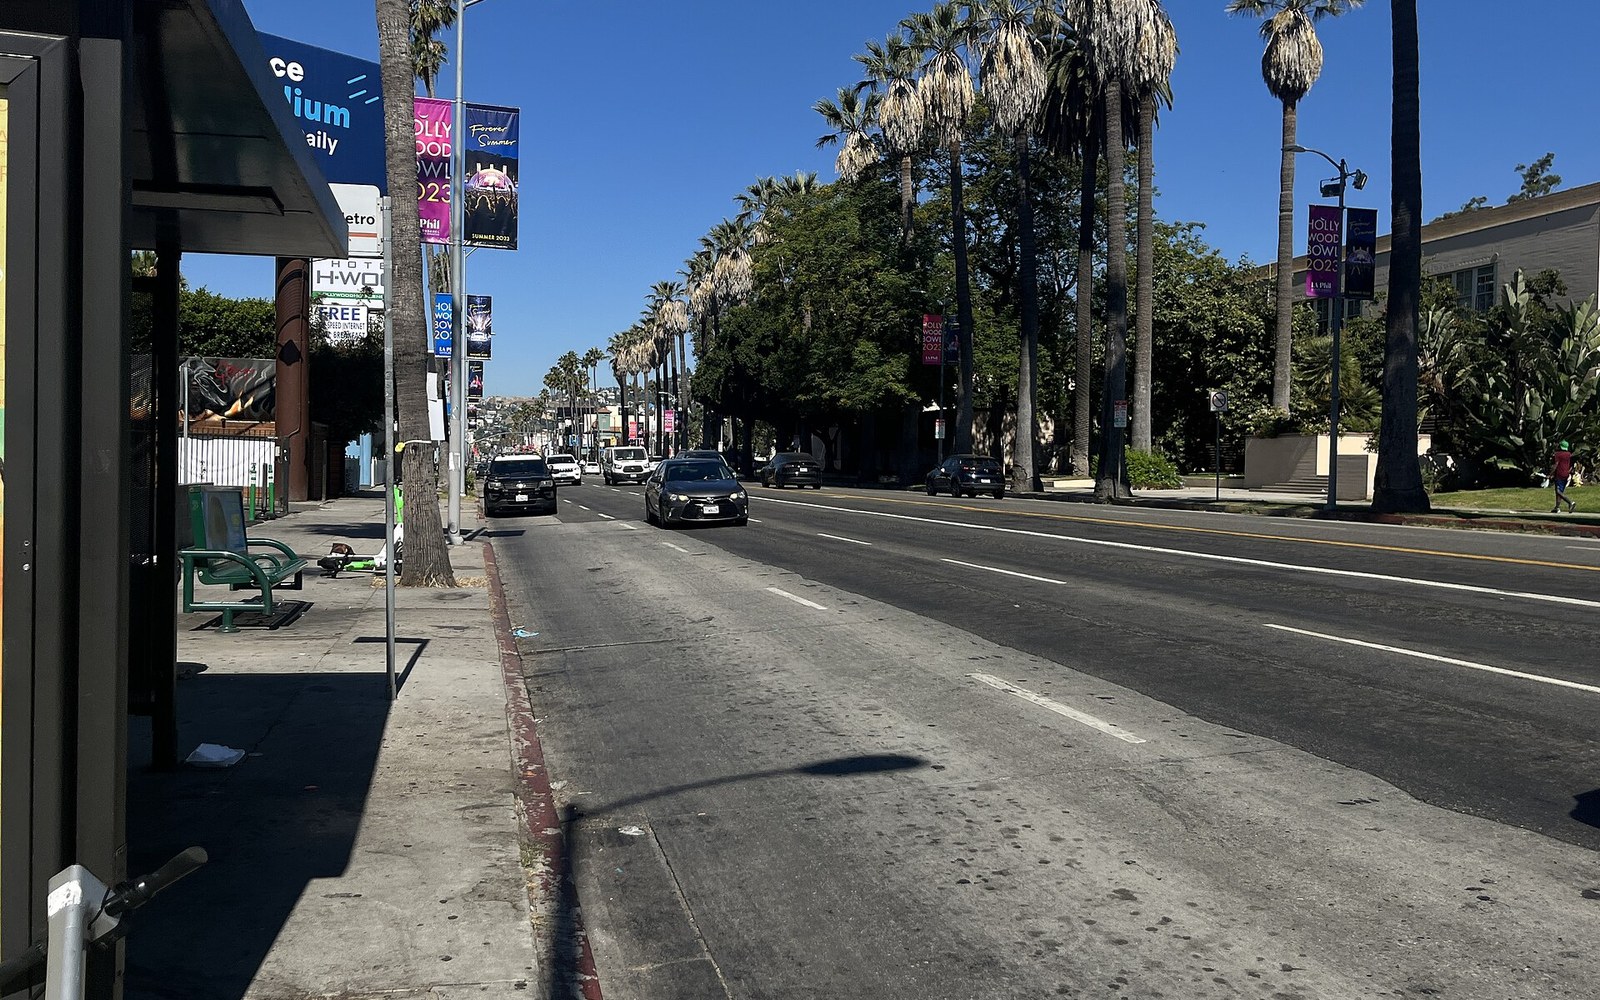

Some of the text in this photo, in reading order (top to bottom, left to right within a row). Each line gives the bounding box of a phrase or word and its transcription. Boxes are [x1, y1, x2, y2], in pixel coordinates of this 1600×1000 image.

[269, 57, 304, 82] ce
[469, 123, 508, 137] Forever
[302, 129, 339, 156] aily
[478, 134, 517, 148] Summer
[344, 212, 376, 226] etro
[420, 218, 440, 230] Phil
[1308, 218, 1340, 232] HOLLY
[471, 233, 495, 241] SUMMER
[1308, 232, 1340, 244] WOOD
[1307, 244, 1338, 258] BOWL
[1307, 258, 1338, 273] 2023
[319, 306, 361, 321] FREE
[435, 312, 452, 320] WO
[343, 322, 366, 331] INTERNET
[923, 321, 942, 329] OLLY
[435, 330, 452, 340] 20
